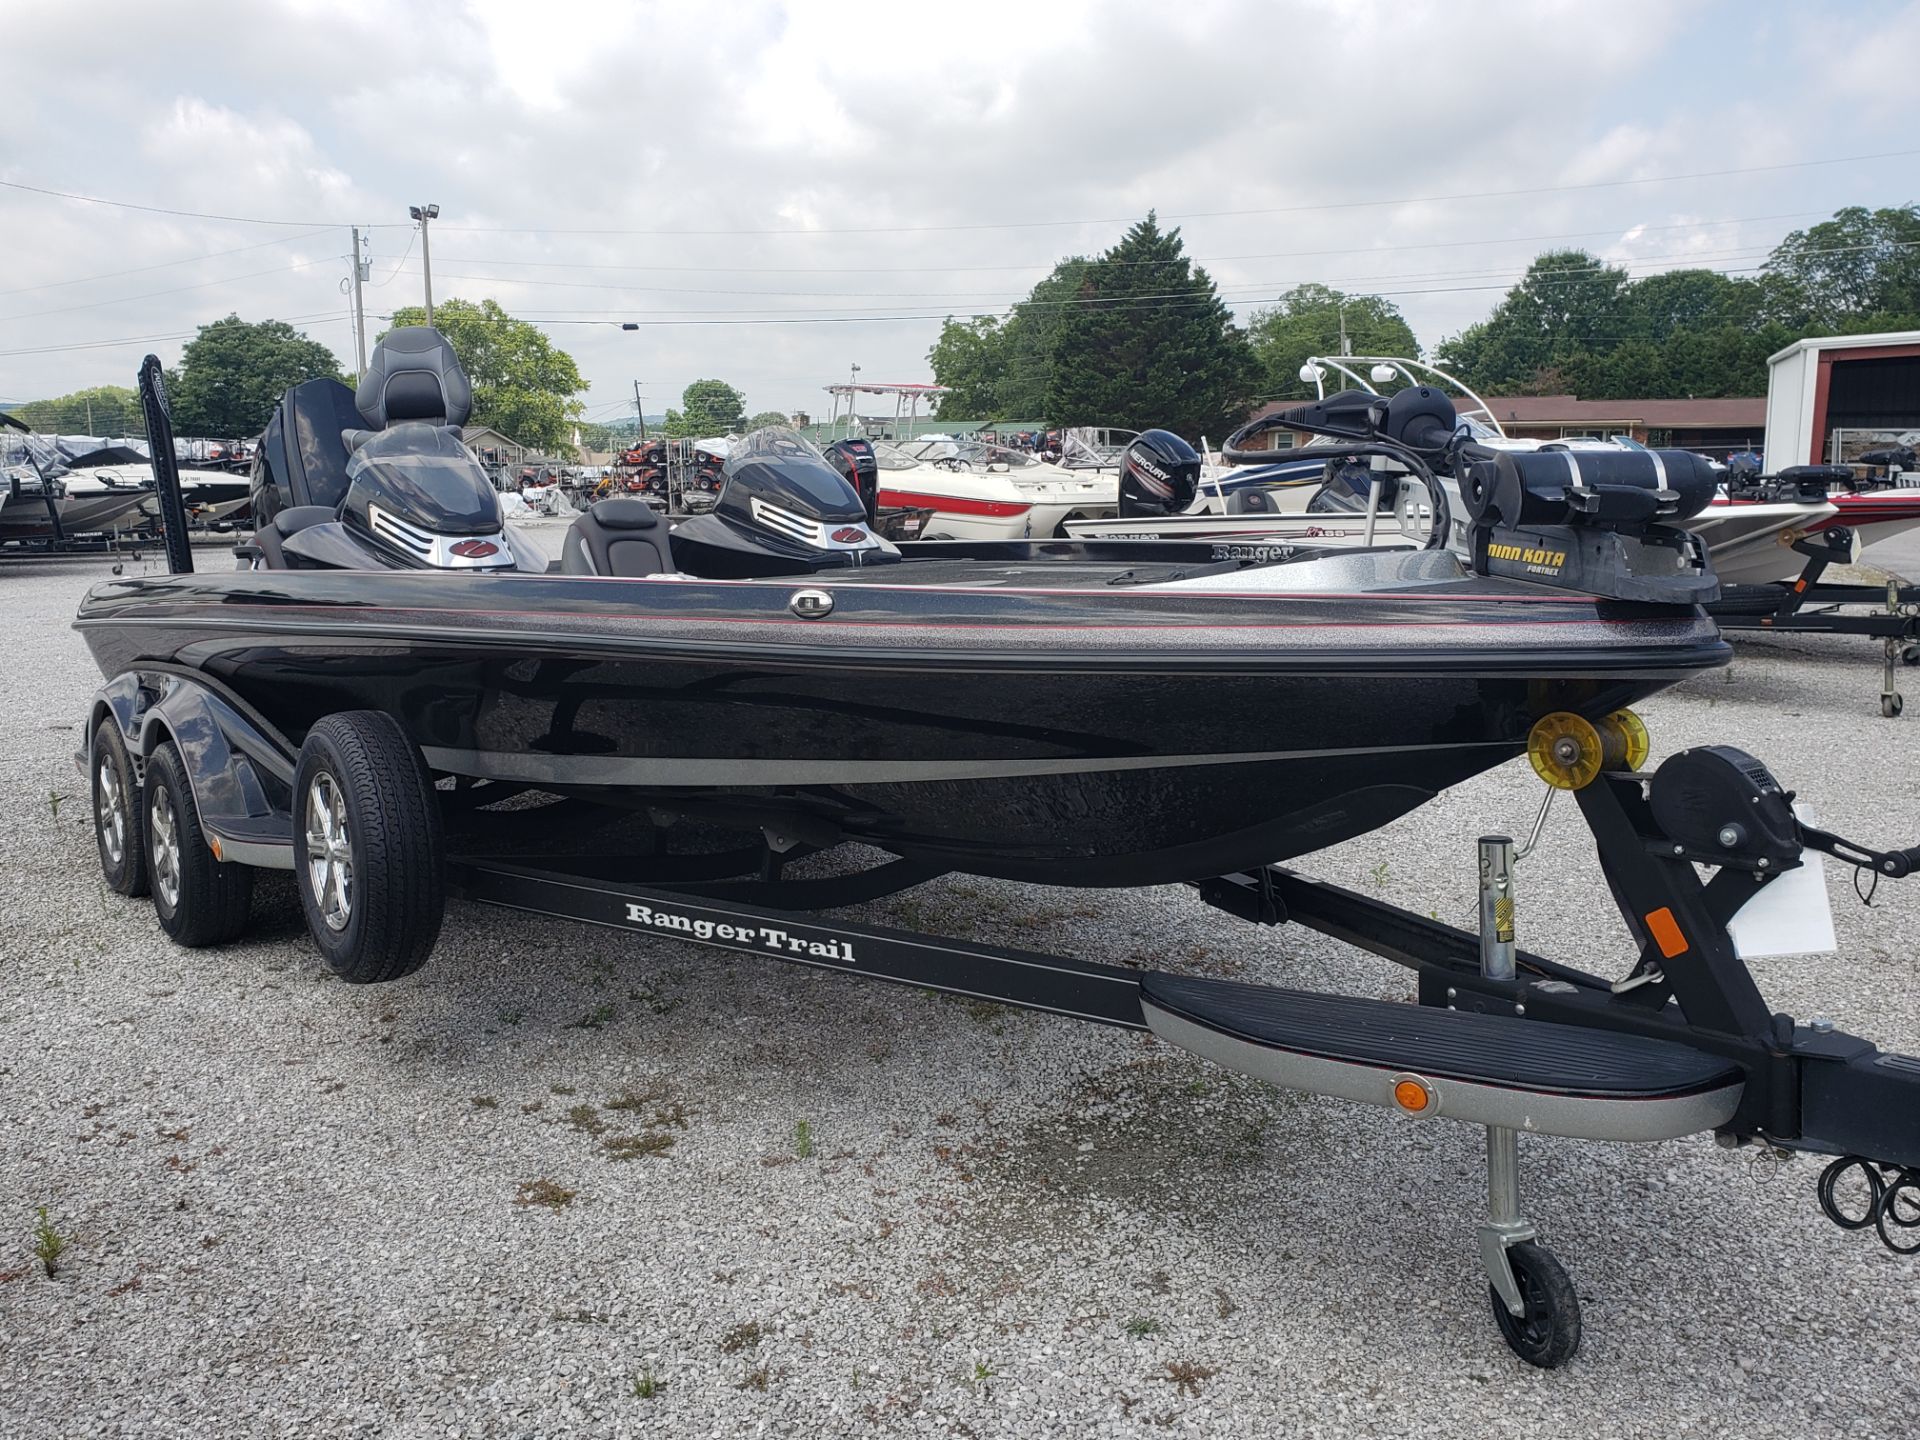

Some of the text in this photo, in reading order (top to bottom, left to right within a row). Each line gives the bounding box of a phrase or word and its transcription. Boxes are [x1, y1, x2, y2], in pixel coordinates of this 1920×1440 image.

[1130, 448, 1171, 481] MERCURY
[1211, 544, 1294, 563] Ranger
[1522, 548, 1565, 567] KOTA
[1527, 565, 1560, 576] FORTREX
[625, 902, 856, 962] Ranger Trail
